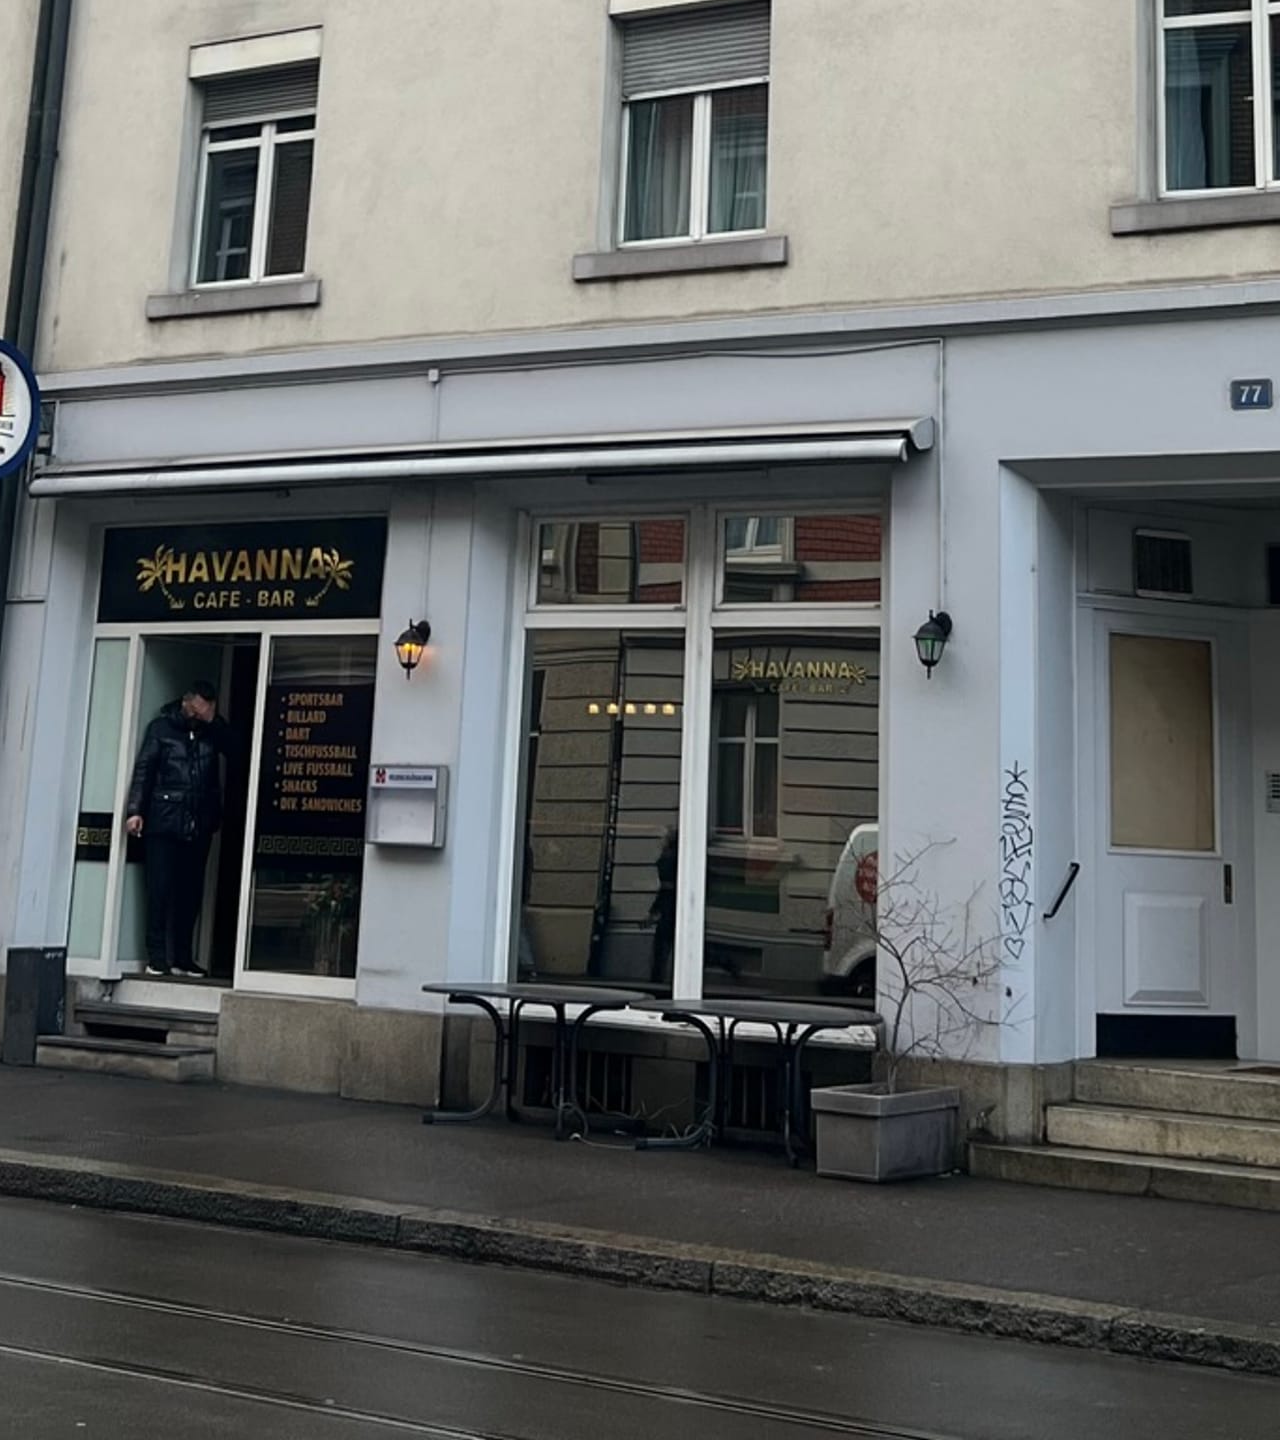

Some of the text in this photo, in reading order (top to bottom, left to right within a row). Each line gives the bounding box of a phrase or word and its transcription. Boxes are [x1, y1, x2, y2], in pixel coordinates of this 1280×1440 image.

[1240, 385, 1262, 403] 77
[165, 547, 326, 583] HAVANNA
[193, 589, 295, 609] CAFE BAR
[751, 661, 851, 678] HAVANNA
[288, 693, 344, 706] SPORTSBAR
[287, 710, 327, 723] BILLARD
[285, 727, 312, 740] DART
[285, 745, 357, 759] TISCHFUSSBALL
[283, 763, 354, 777] LIVE FUSSBALL
[281, 780, 318, 793] SNACKS
[301, 798, 363, 812] SANDWICHES
